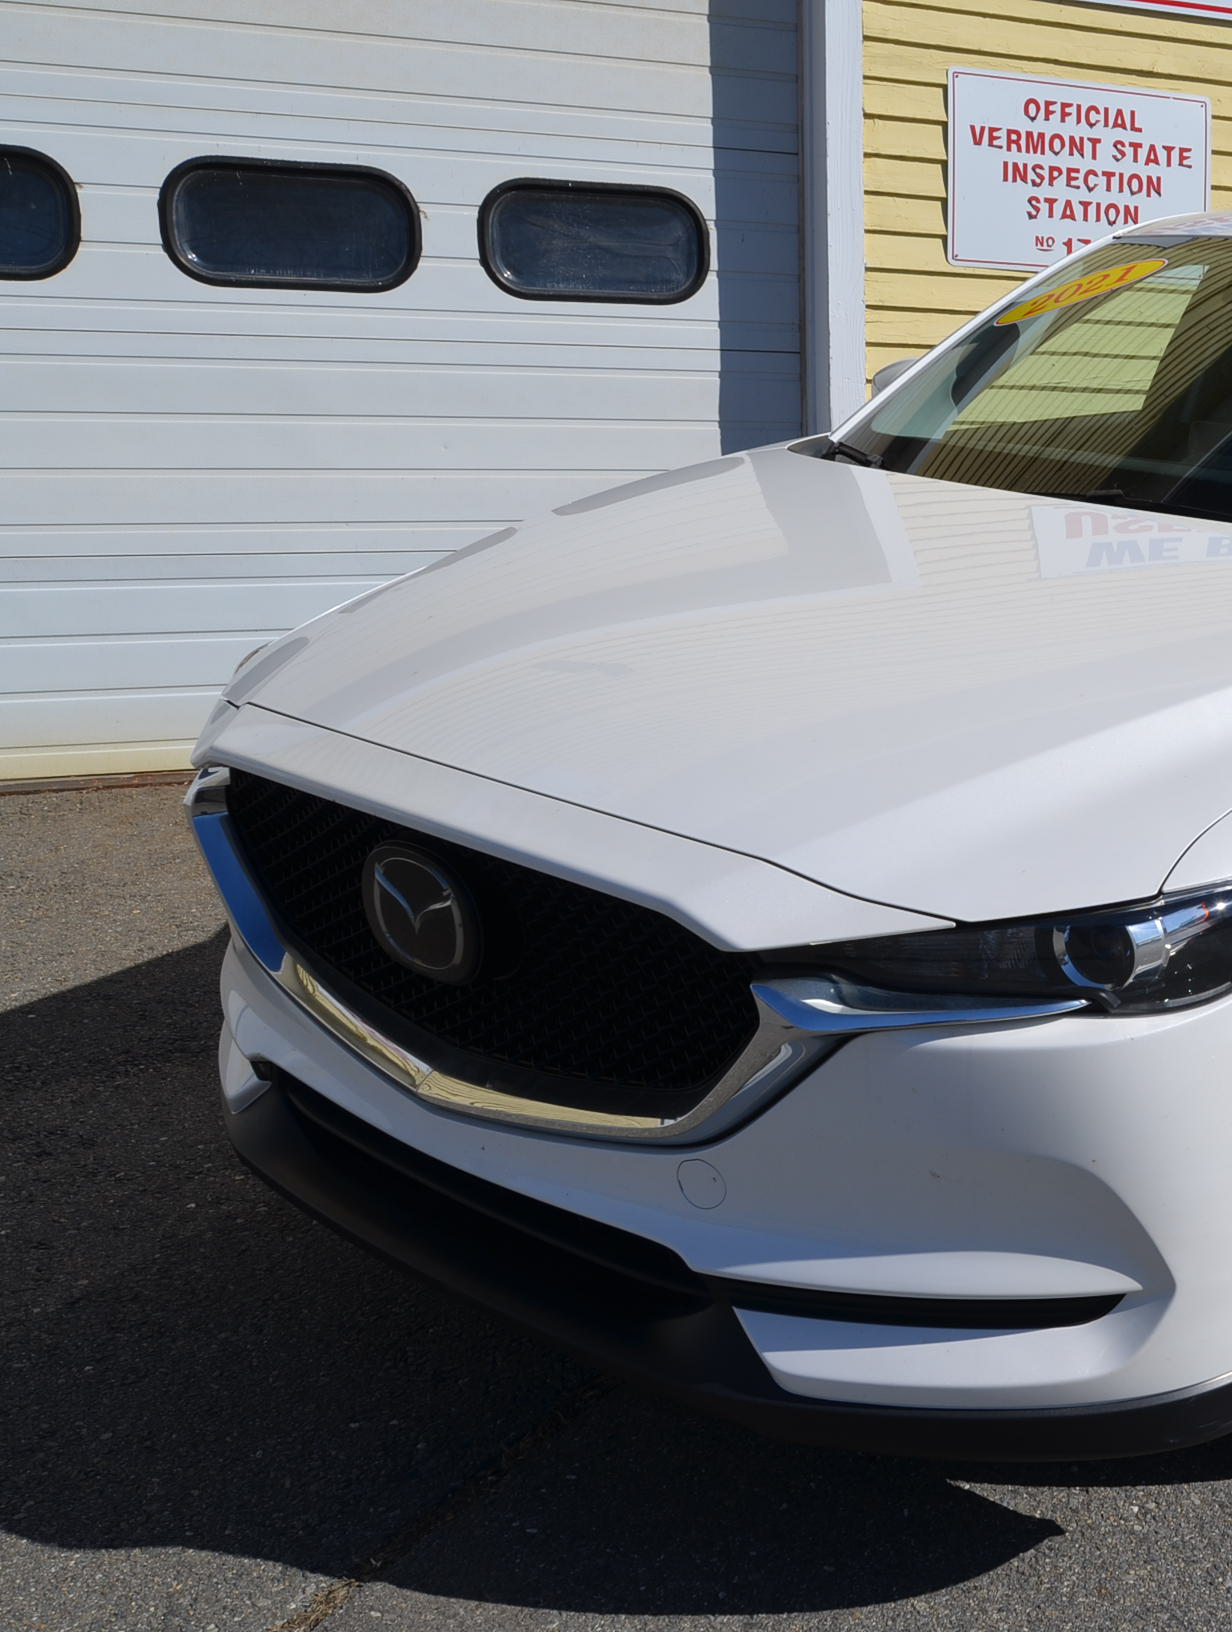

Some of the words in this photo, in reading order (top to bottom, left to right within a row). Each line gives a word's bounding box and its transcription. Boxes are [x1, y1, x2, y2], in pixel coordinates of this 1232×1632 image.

[1023, 97, 1143, 133] OFFICIAL
[969, 124, 1102, 161] VERMONT
[1112, 139, 1193, 169] STATE
[1002, 160, 1162, 198] INSPECTION
[1026, 195, 1140, 227] STATION
[1022, 264, 1138, 317] 2021
